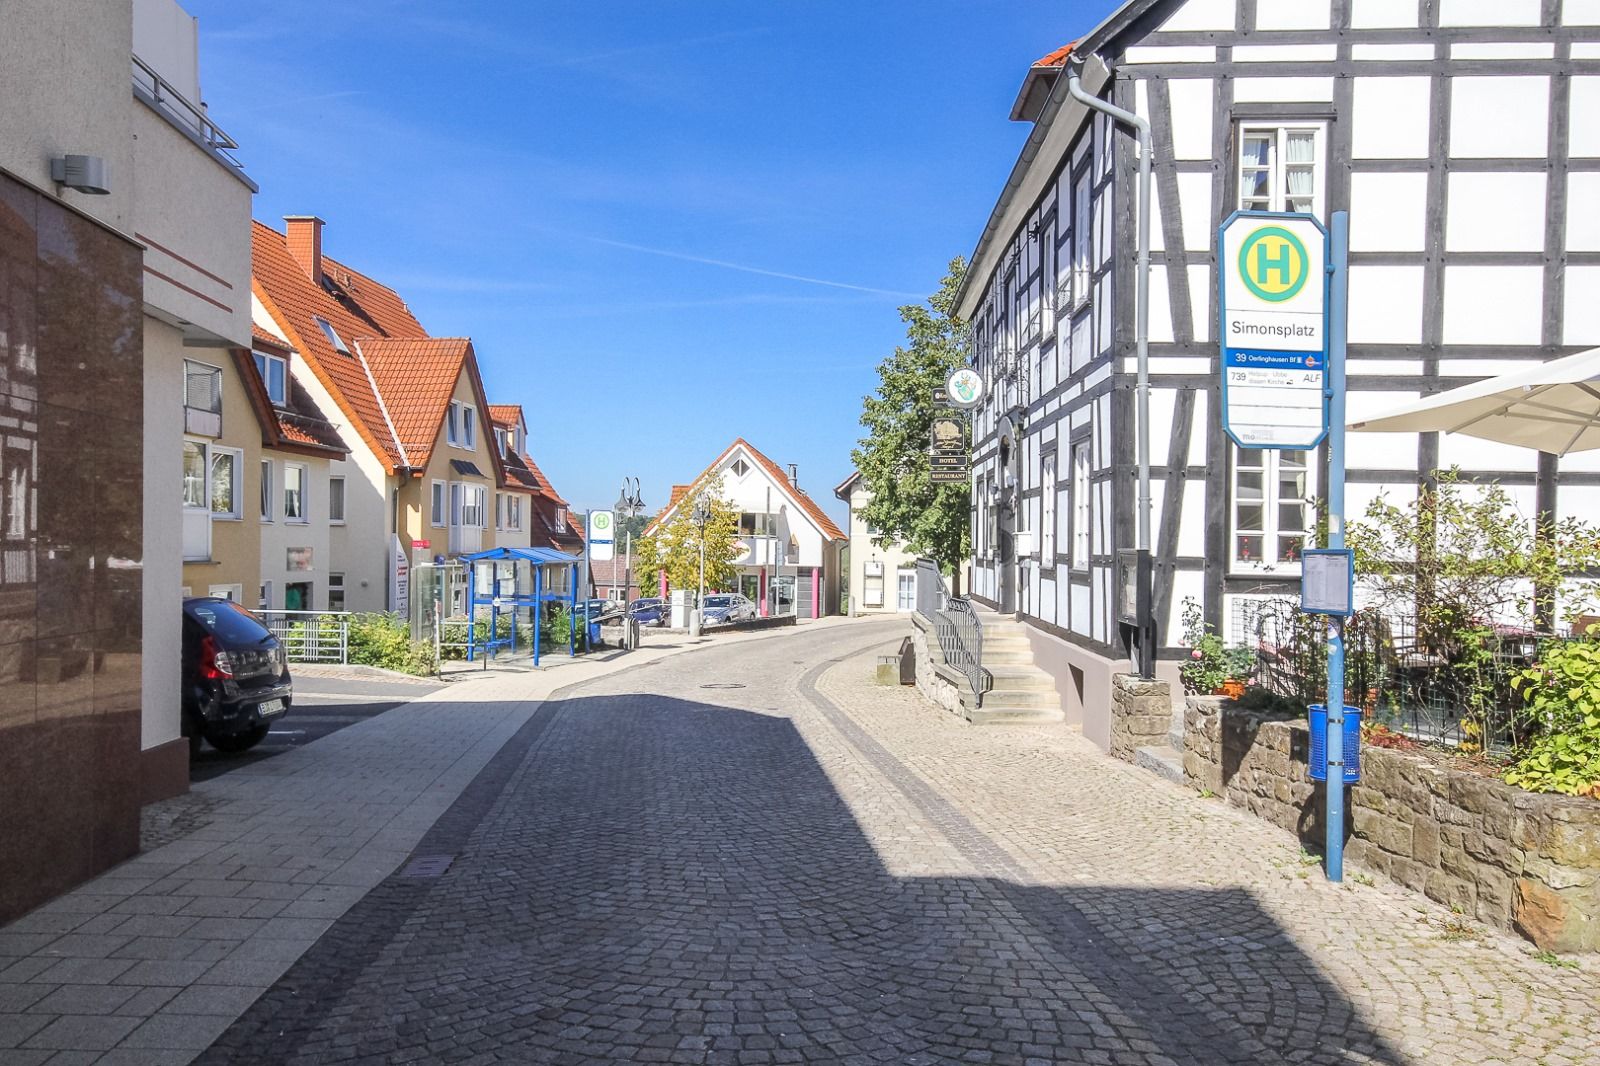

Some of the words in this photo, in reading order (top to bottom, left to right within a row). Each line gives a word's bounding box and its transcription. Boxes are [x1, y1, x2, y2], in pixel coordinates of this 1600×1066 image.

[1257, 243, 1290, 285] H
[1232, 321, 1315, 338] Simonsplatz
[1235, 353, 1247, 362] 39
[1248, 354, 1289, 364] Oerlinghausen
[1231, 371, 1246, 381] 739
[1303, 373, 1321, 383] ALF
[597, 517, 606, 526] H
